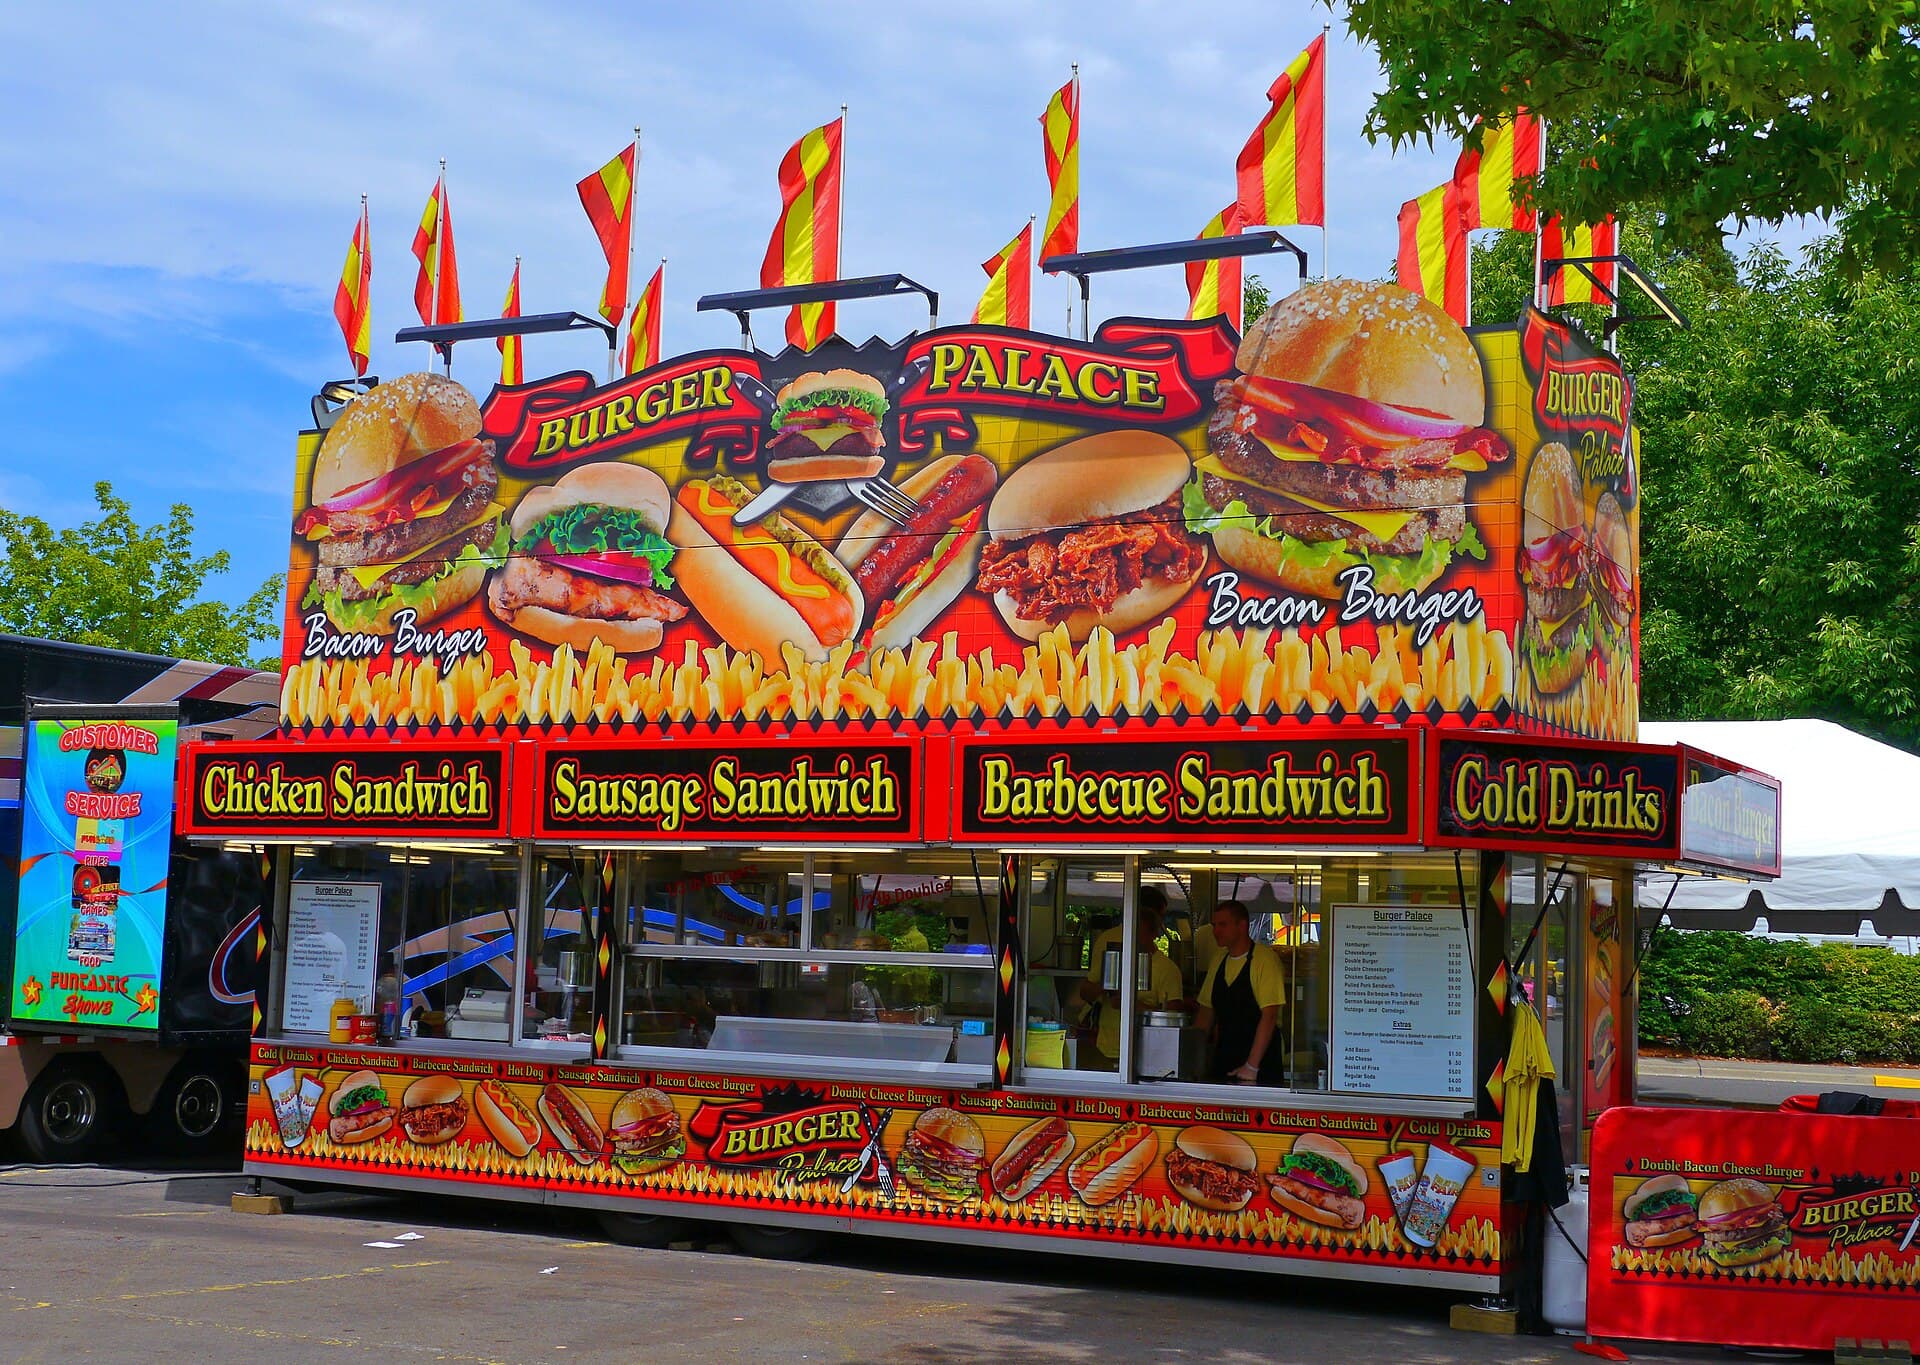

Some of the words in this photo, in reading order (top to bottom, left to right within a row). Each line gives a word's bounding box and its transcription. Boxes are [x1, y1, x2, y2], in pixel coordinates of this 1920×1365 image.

[534, 366, 734, 457] BURGER
[929, 344, 1165, 409] PALACE
[1546, 371, 1623, 424] BURGER
[1580, 430, 1625, 480] Palace
[1207, 571, 1326, 625] Bacon
[1339, 566, 1482, 646] Burger
[304, 612, 384, 656] Bacon
[393, 609, 487, 674] Burger
[59, 724, 159, 755] CUSTOMER
[203, 764, 325, 815] Chicken
[332, 764, 489, 815] Sandwich
[554, 763, 702, 831] Sausage
[712, 759, 896, 815] Sandwich
[983, 758, 1167, 817] Barbecue
[1179, 755, 1386, 817] Sandwich
[1455, 760, 1538, 826] Cold
[1547, 766, 1661, 833] Drinks
[65, 791, 142, 819] SERVICE
[1690, 769, 1731, 832] Bacon
[1734, 786, 1775, 859] Burger
[85, 855, 110, 867] RIDES
[894, 880, 952, 903] Doubles
[80, 905, 109, 917] GAMES
[1373, 910, 1403, 921] Burger
[1404, 910, 1433, 921] Palace
[79, 956, 102, 968] FOOD
[50, 971, 129, 994] FUNTASTIC
[1392, 1020, 1412, 1029] Extras
[258, 1047, 277, 1059] Cold
[287, 1049, 314, 1062] Drinks
[327, 1052, 358, 1065] Chicken
[360, 1054, 399, 1068] Sandwich
[412, 1058, 451, 1071] Barbecue
[453, 1061, 494, 1074] Sandwich
[507, 1064, 523, 1076] Hot
[525, 1065, 544, 1080] Dog
[558, 1068, 595, 1084] Sausage
[597, 1070, 640, 1085] Sandwich
[656, 1074, 685, 1088] Bacon
[687, 1076, 720, 1090] Cheese
[723, 1078, 756, 1093] Burger
[831, 1085, 868, 1100] Double
[870, 1088, 903, 1103] Cheese
[906, 1090, 943, 1105] Burger
[959, 1093, 1003, 1110] Sausage
[1006, 1096, 1057, 1111] Sandwich
[1075, 1100, 1096, 1114] Hot
[1098, 1102, 1121, 1118] Dog
[1140, 1104, 1191, 1120] Barbecue
[1194, 1107, 1250, 1123] Sandwich
[1270, 1111, 1316, 1127] Chicken
[1320, 1115, 1378, 1132] Sandwich
[1409, 1120, 1440, 1135] Cold
[1445, 1122, 1491, 1139] Drinks
[724, 1110, 862, 1156] BURGER
[778, 1148, 862, 1185] Palace
[1640, 1158, 1681, 1173] Double
[1683, 1160, 1719, 1173] Bacon
[1722, 1162, 1761, 1176] Cheese
[1765, 1164, 1804, 1180] Burger
[1802, 1192, 1914, 1226] BURGER
[1828, 1219, 1895, 1248] Palace
